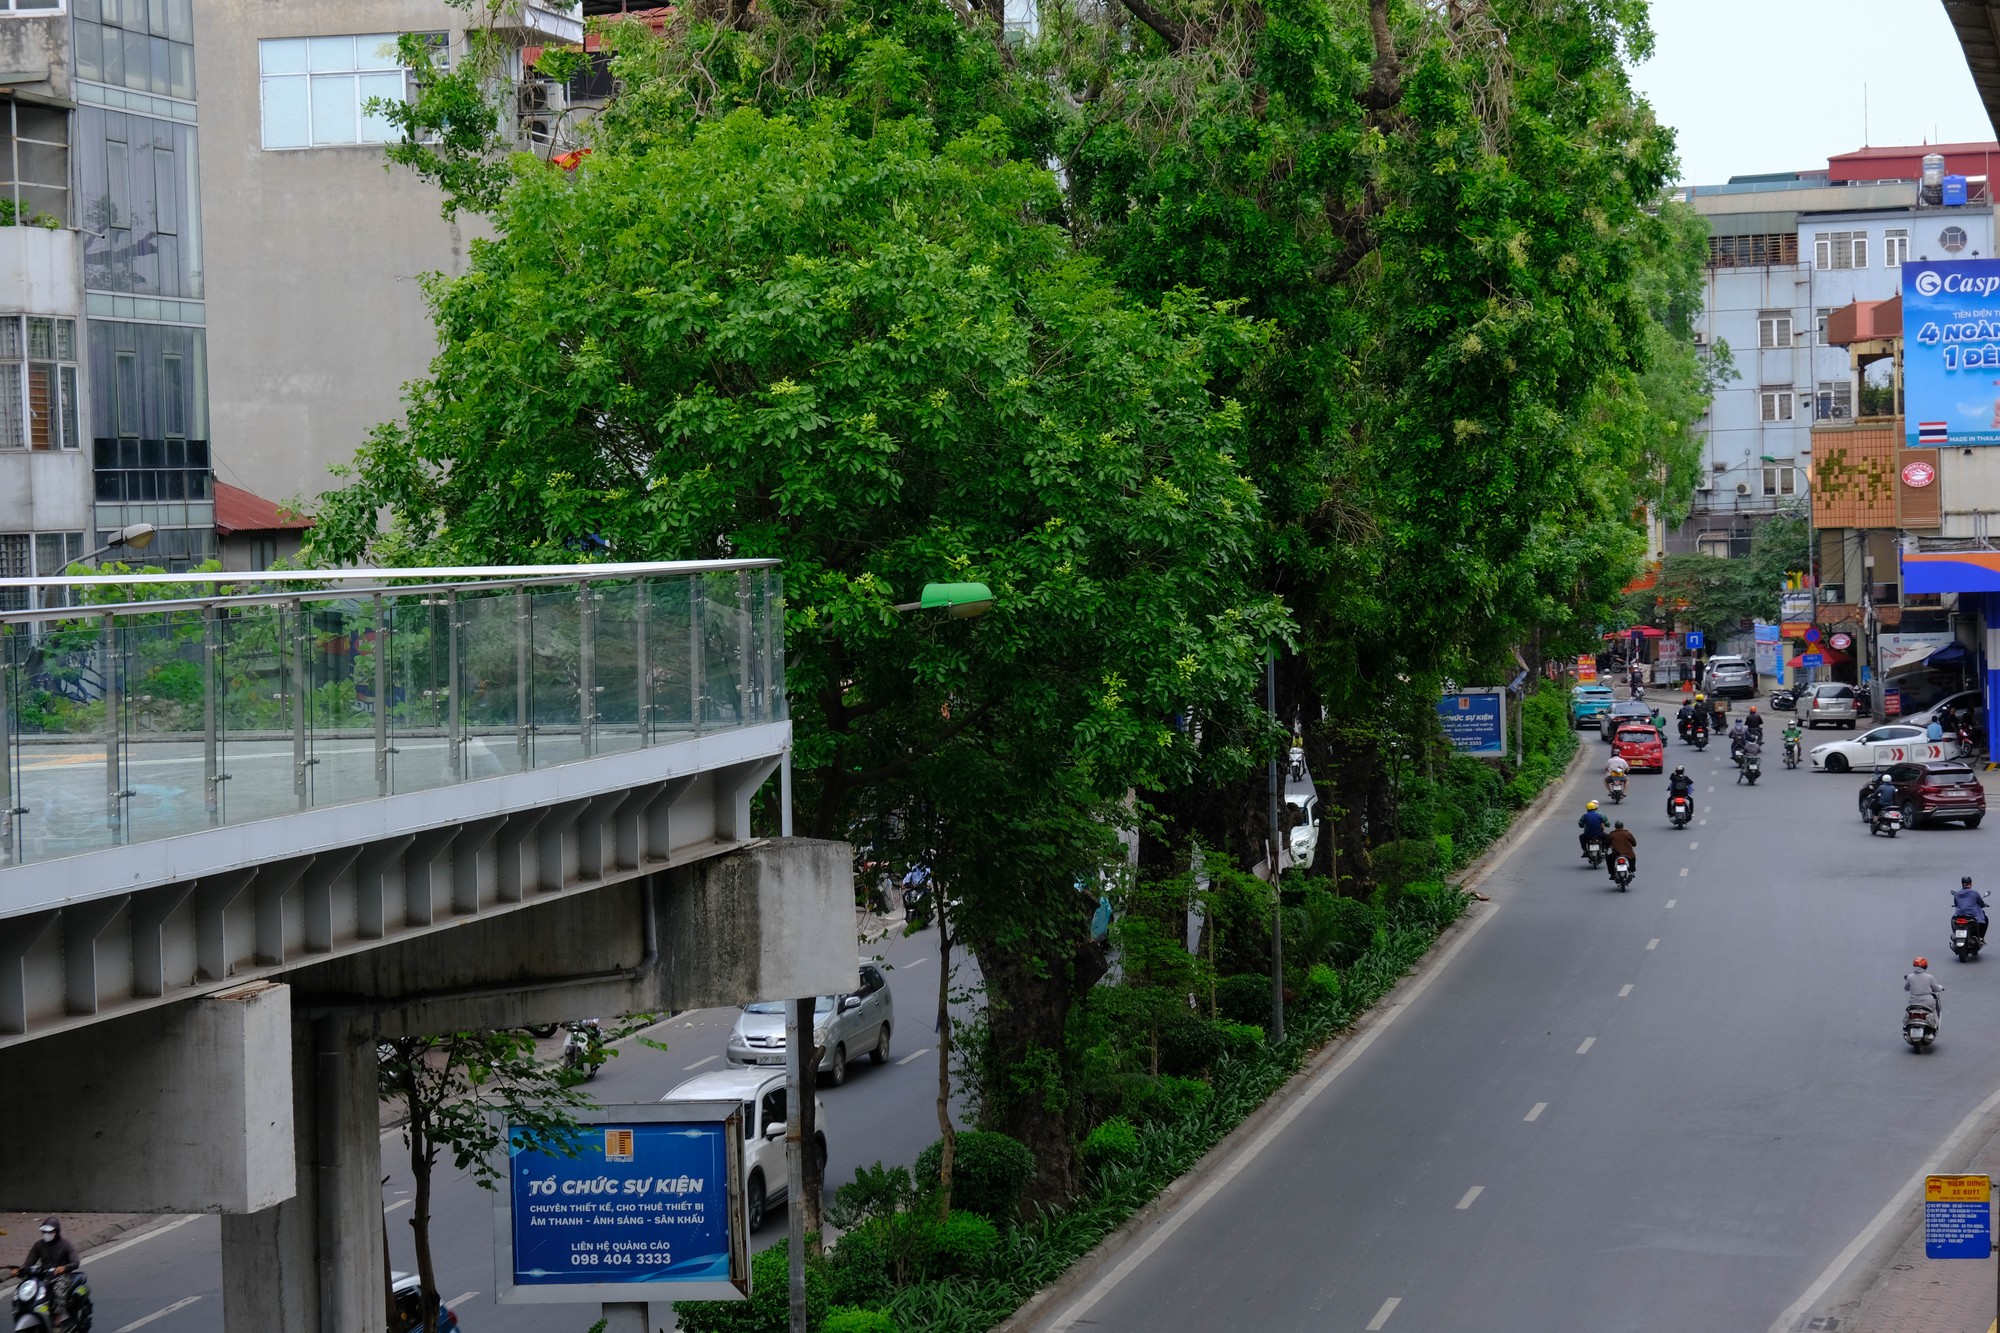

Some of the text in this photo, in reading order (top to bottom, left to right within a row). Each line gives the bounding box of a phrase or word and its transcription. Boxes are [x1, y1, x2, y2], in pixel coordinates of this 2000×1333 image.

[1918, 323, 1939, 343] 4
[1944, 344, 2000, 369] 1 ĐÊ
[529, 1174, 704, 1198] TỔ CHỨC SỰ KIỆN
[530, 1203, 567, 1212] CHUYÊN
[570, 1201, 597, 1212] THIẾT
[599, 1201, 614, 1213] KẾ,
[638, 1201, 663, 1211] THUÊ
[665, 1200, 692, 1211] THIẾT
[695, 1203, 704, 1212] BỊ
[530, 1216, 546, 1226] ÂM
[548, 1218, 583, 1226] THANH
[593, 1215, 614, 1225] ÁNH
[617, 1215, 644, 1225] SÁNG
[654, 1214, 674, 1224] SÂN
[677, 1213, 704, 1224] KHẤU
[571, 1240, 670, 1252] LIÊN HỆ QUẢNG CÁO
[571, 1253, 671, 1265] 098 404 3333
